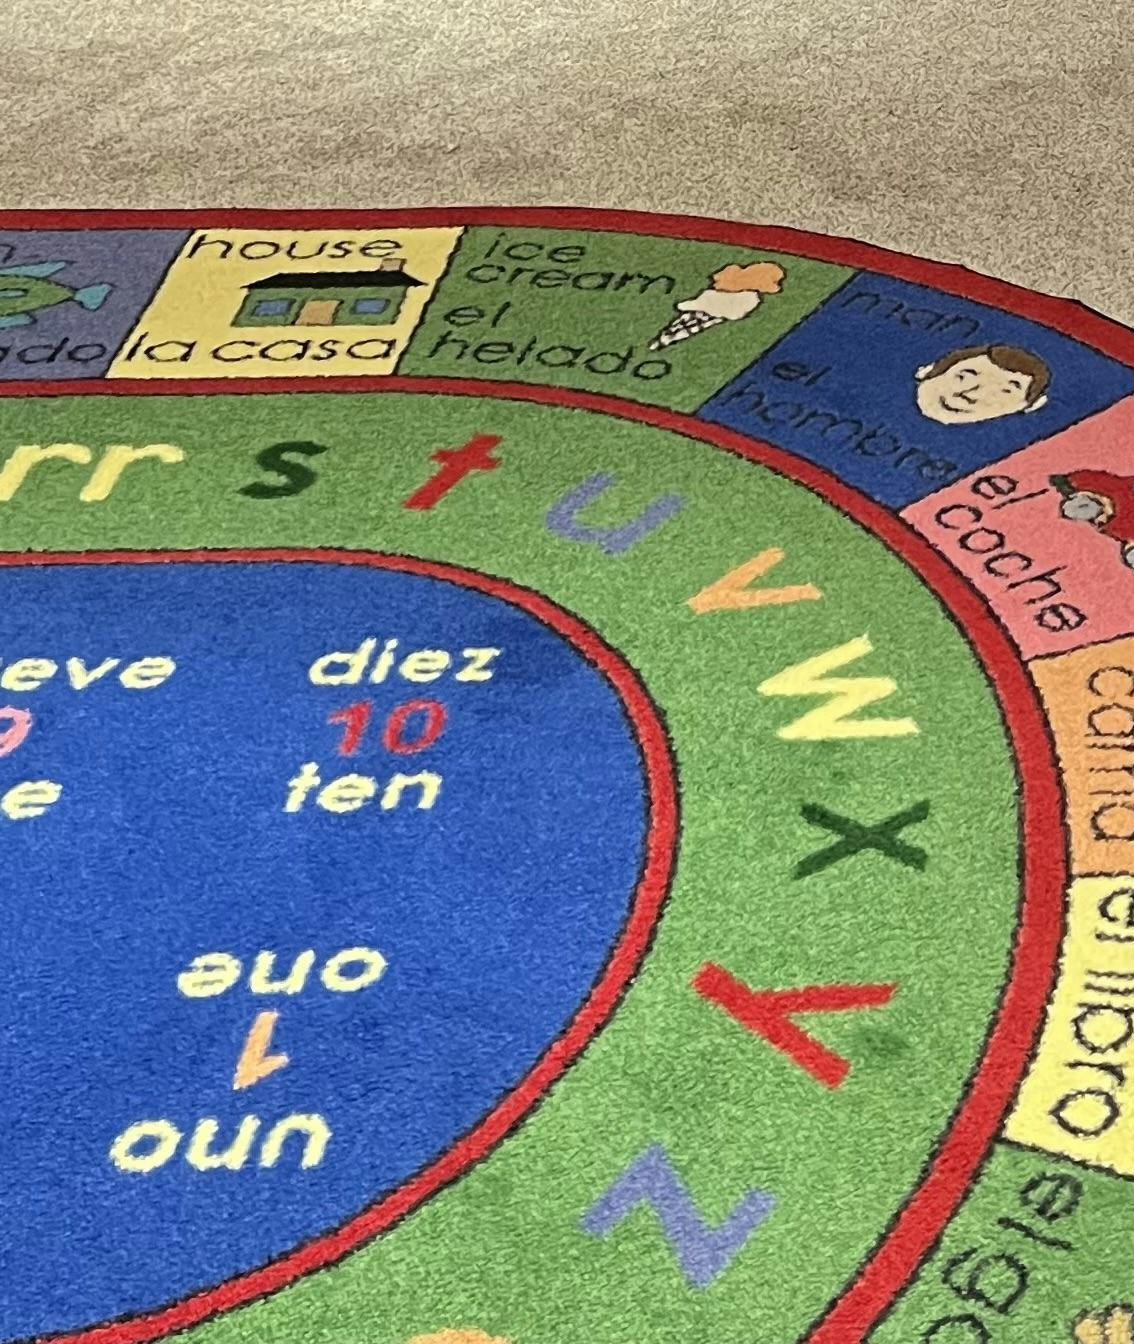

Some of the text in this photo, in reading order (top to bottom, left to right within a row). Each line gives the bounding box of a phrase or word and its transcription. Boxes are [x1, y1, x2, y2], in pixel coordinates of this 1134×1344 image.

[186, 233, 403, 263] house
[481, 232, 587, 264] ice
[463, 261, 678, 297] cream
[442, 301, 510, 328] el
[837, 282, 983, 337] man
[123, 335, 400, 365] la casa
[425, 333, 675, 385] helado
[771, 358, 824, 388] el
[719, 384, 962, 484] hombre
[402, 433, 505, 510] t
[970, 471, 1048, 508] el
[934, 498, 1088, 634] coche
[308, 637, 504, 688] diez
[328, 699, 449, 757] 10
[284, 762, 443, 814] ten
[176, 947, 388, 999] one
[233, 1010, 289, 1092] 1
[109, 1112, 332, 1174] uno
[1016, 1169, 1086, 1253] el
